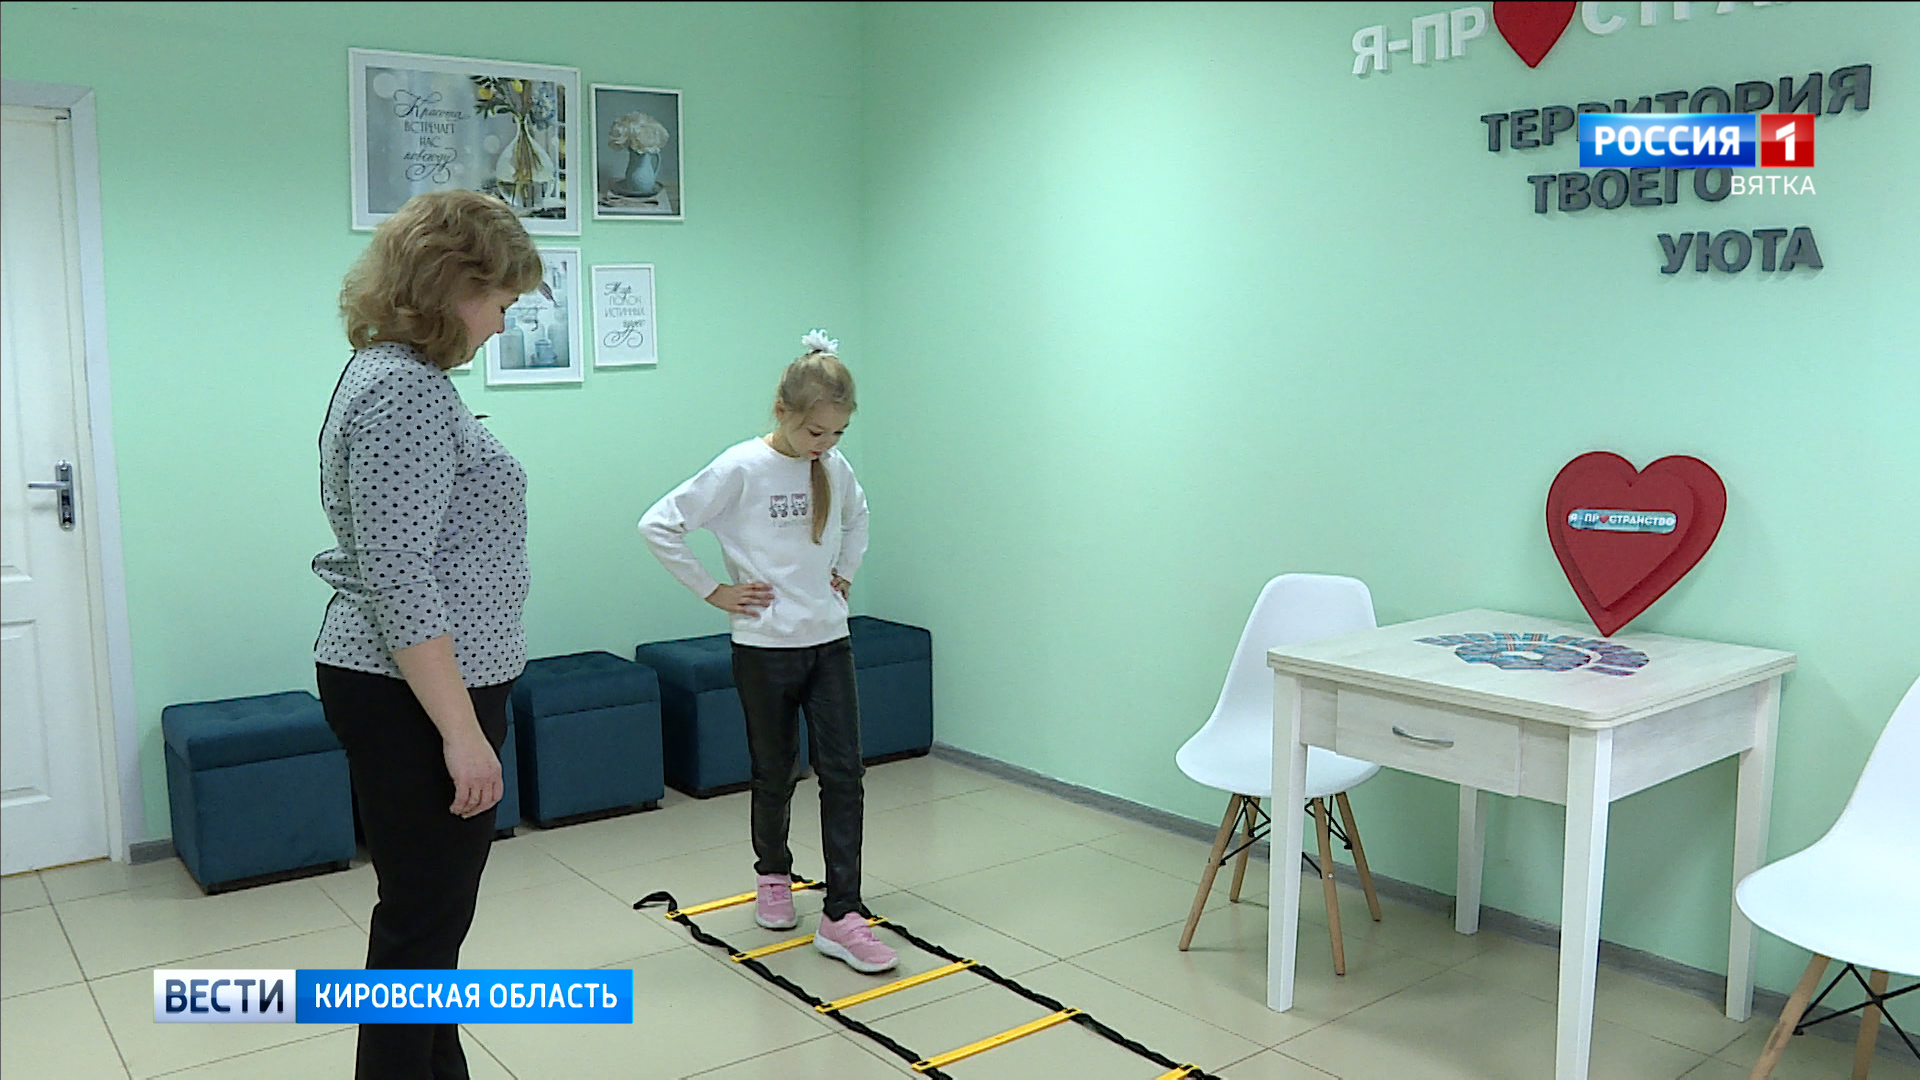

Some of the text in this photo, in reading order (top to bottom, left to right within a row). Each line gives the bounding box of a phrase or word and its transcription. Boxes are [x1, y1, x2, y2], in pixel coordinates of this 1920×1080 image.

[420, 136, 441, 147] НАС
[1528, 167, 1734, 213] ТВОЕГО
[1657, 227, 1824, 274] УЮТА
